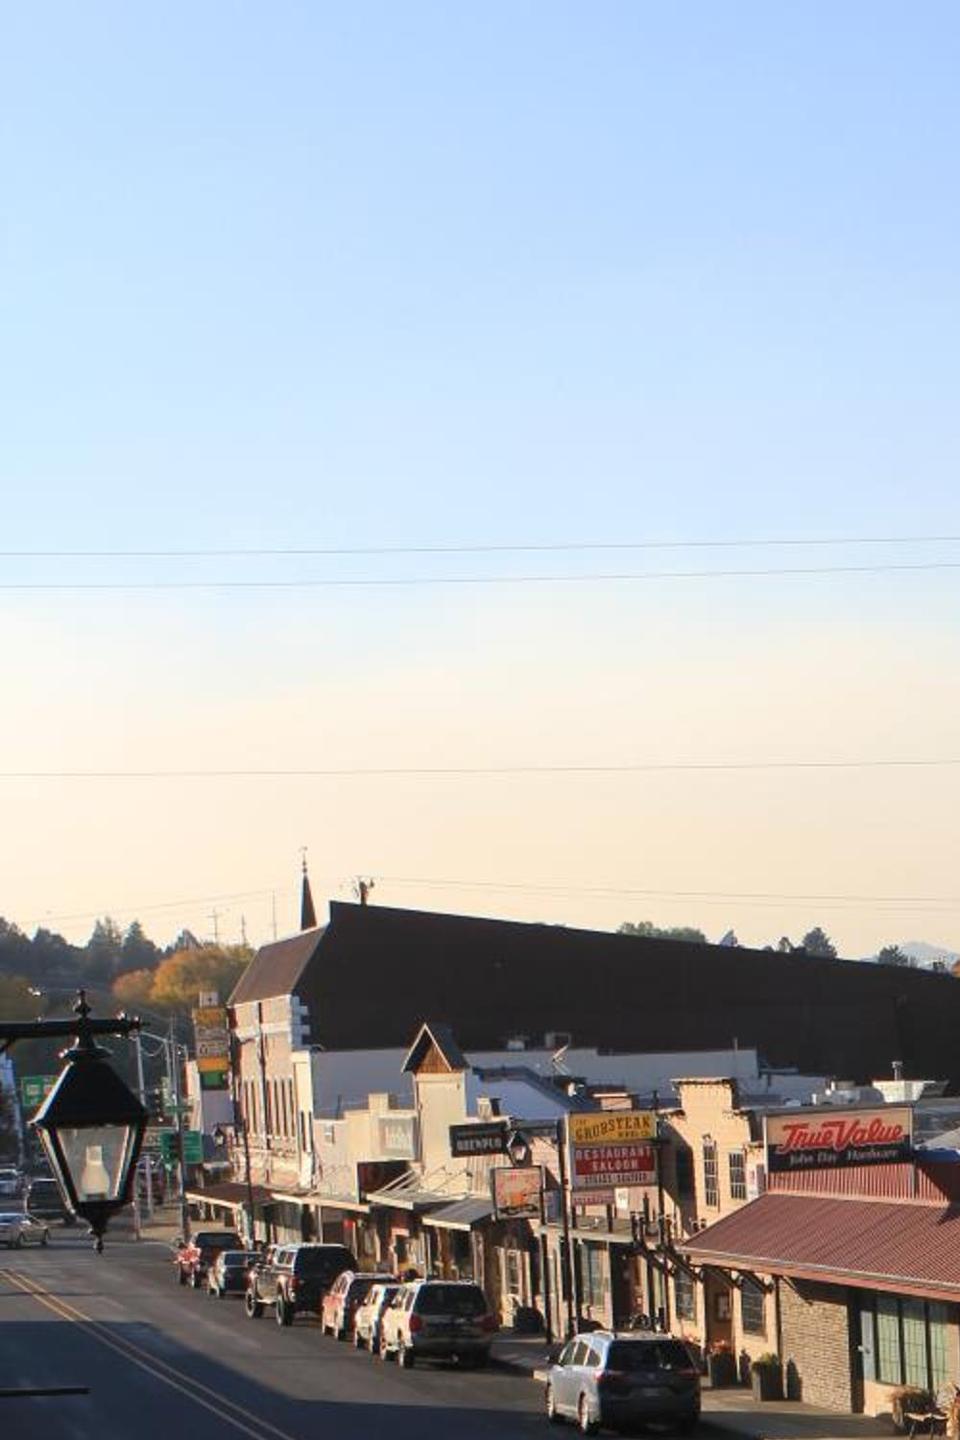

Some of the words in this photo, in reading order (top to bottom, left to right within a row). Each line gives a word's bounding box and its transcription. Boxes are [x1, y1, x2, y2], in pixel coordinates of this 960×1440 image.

[575, 1116, 651, 1139] GRUBSTEAK
[779, 1122, 833, 1153] True
[823, 1118, 903, 1151] Value
[576, 1146, 652, 1161] RESTAURANT
[592, 1159, 639, 1173] SALOON
